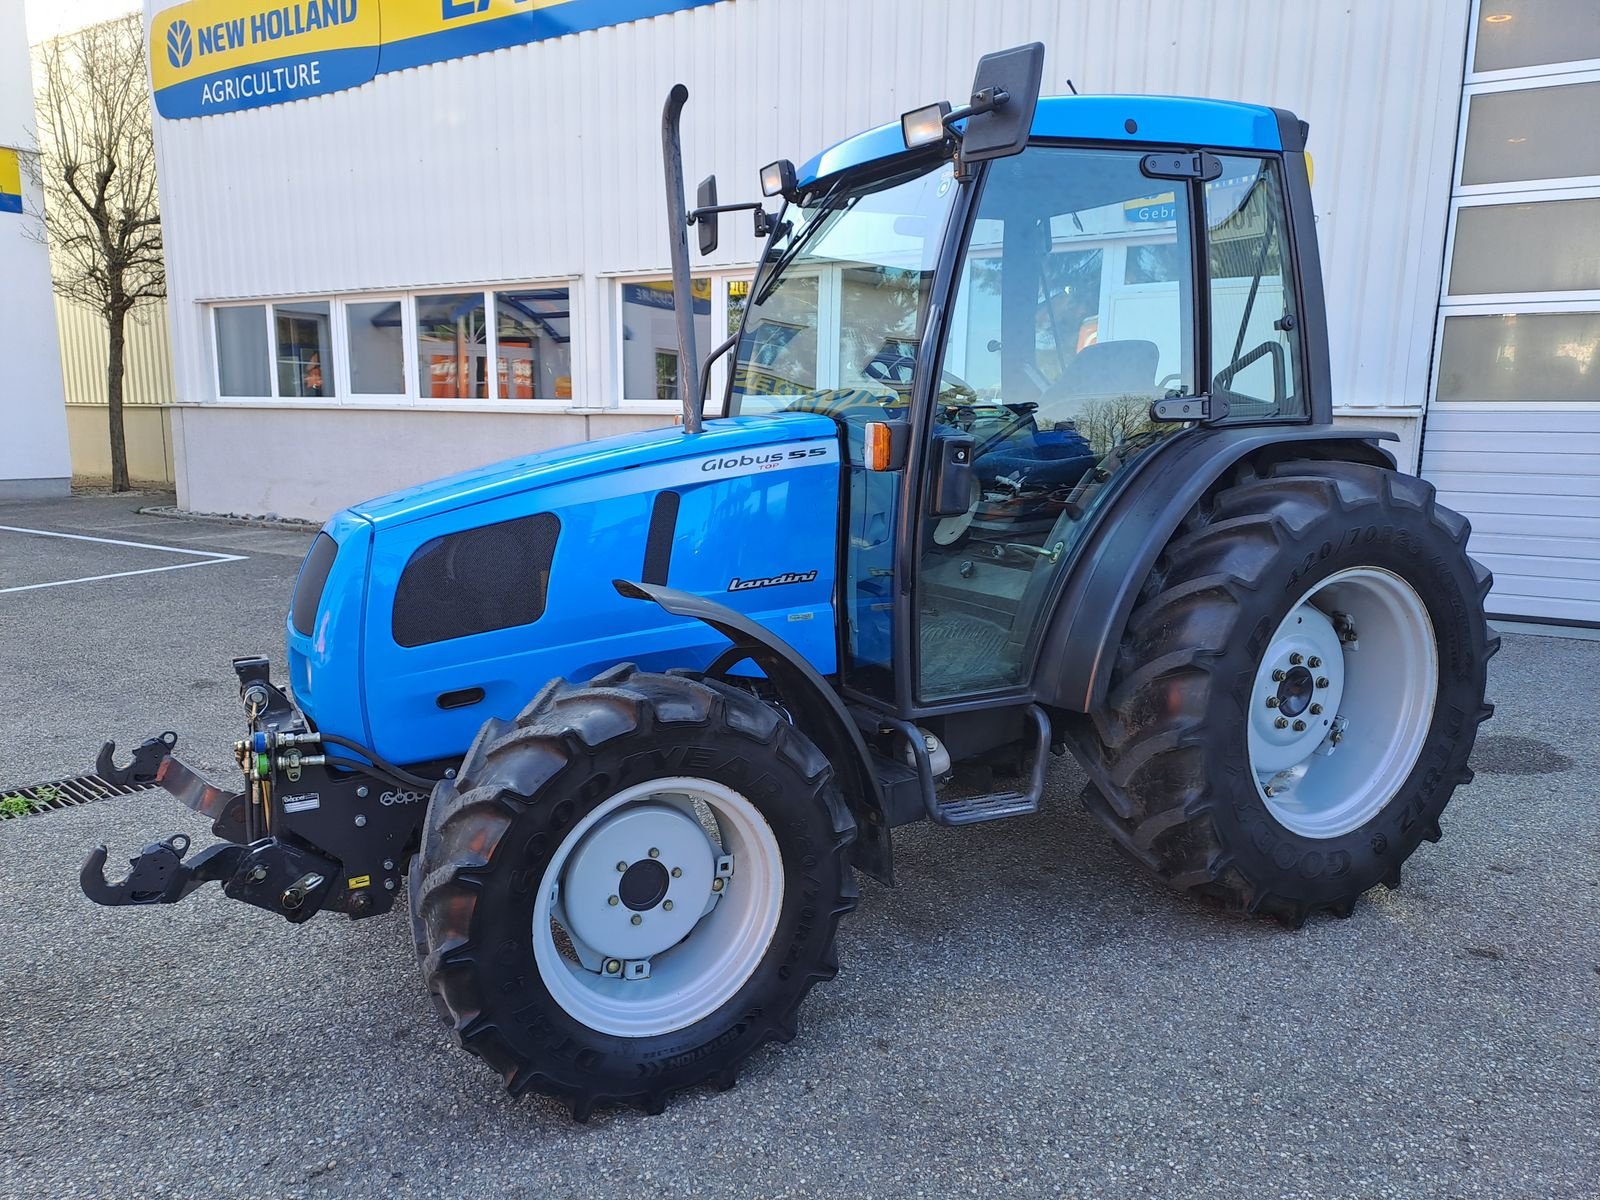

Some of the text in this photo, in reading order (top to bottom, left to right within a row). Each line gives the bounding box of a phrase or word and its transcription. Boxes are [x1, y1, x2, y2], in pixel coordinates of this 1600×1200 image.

[198, 0, 358, 56] NEW HOLLAND
[202, 61, 321, 105] AGRICULTURE
[1138, 207, 1175, 222] Gebr
[701, 447, 827, 472] Globus 55
[758, 462, 780, 471] TOP
[727, 570, 818, 592] Landini
